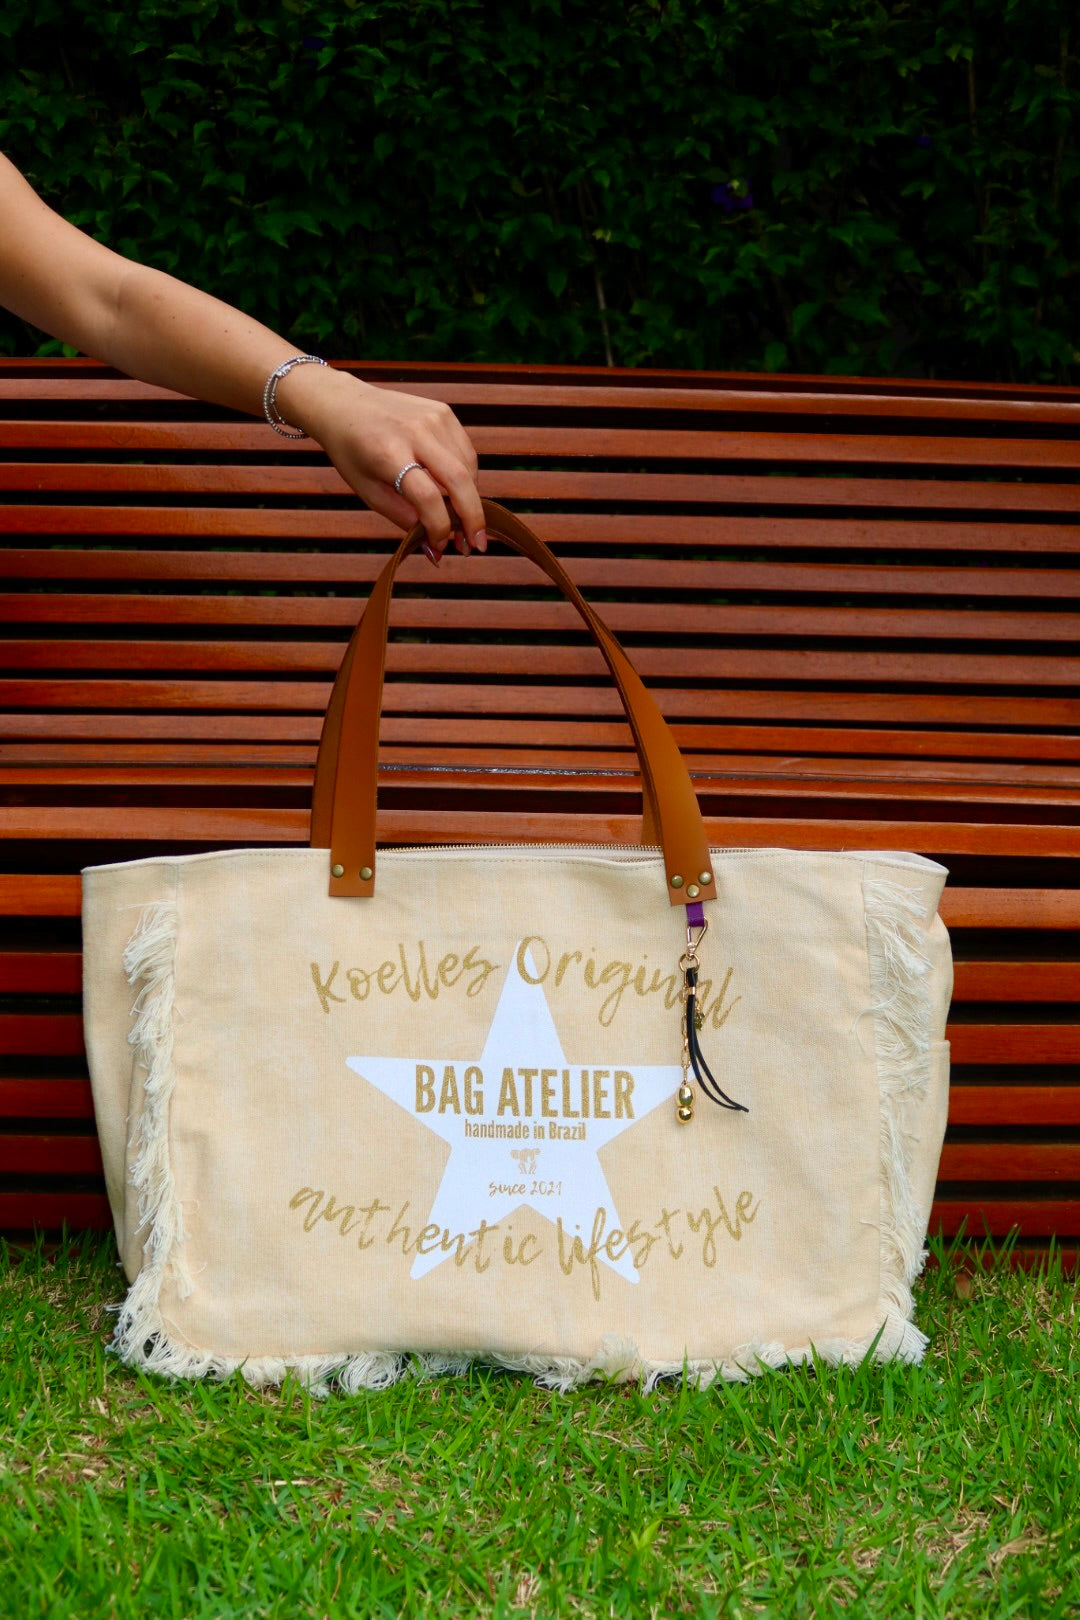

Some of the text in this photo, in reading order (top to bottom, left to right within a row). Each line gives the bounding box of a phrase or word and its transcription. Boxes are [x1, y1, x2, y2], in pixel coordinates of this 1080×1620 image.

[310, 940, 500, 1014] Koelles
[415, 1064, 636, 1120] BAG ATELIER
[464, 1119, 587, 1141] handmade in Brazil
[488, 1180, 563, 1197] since 2021
[289, 1185, 760, 1302] authentic lifestyle
